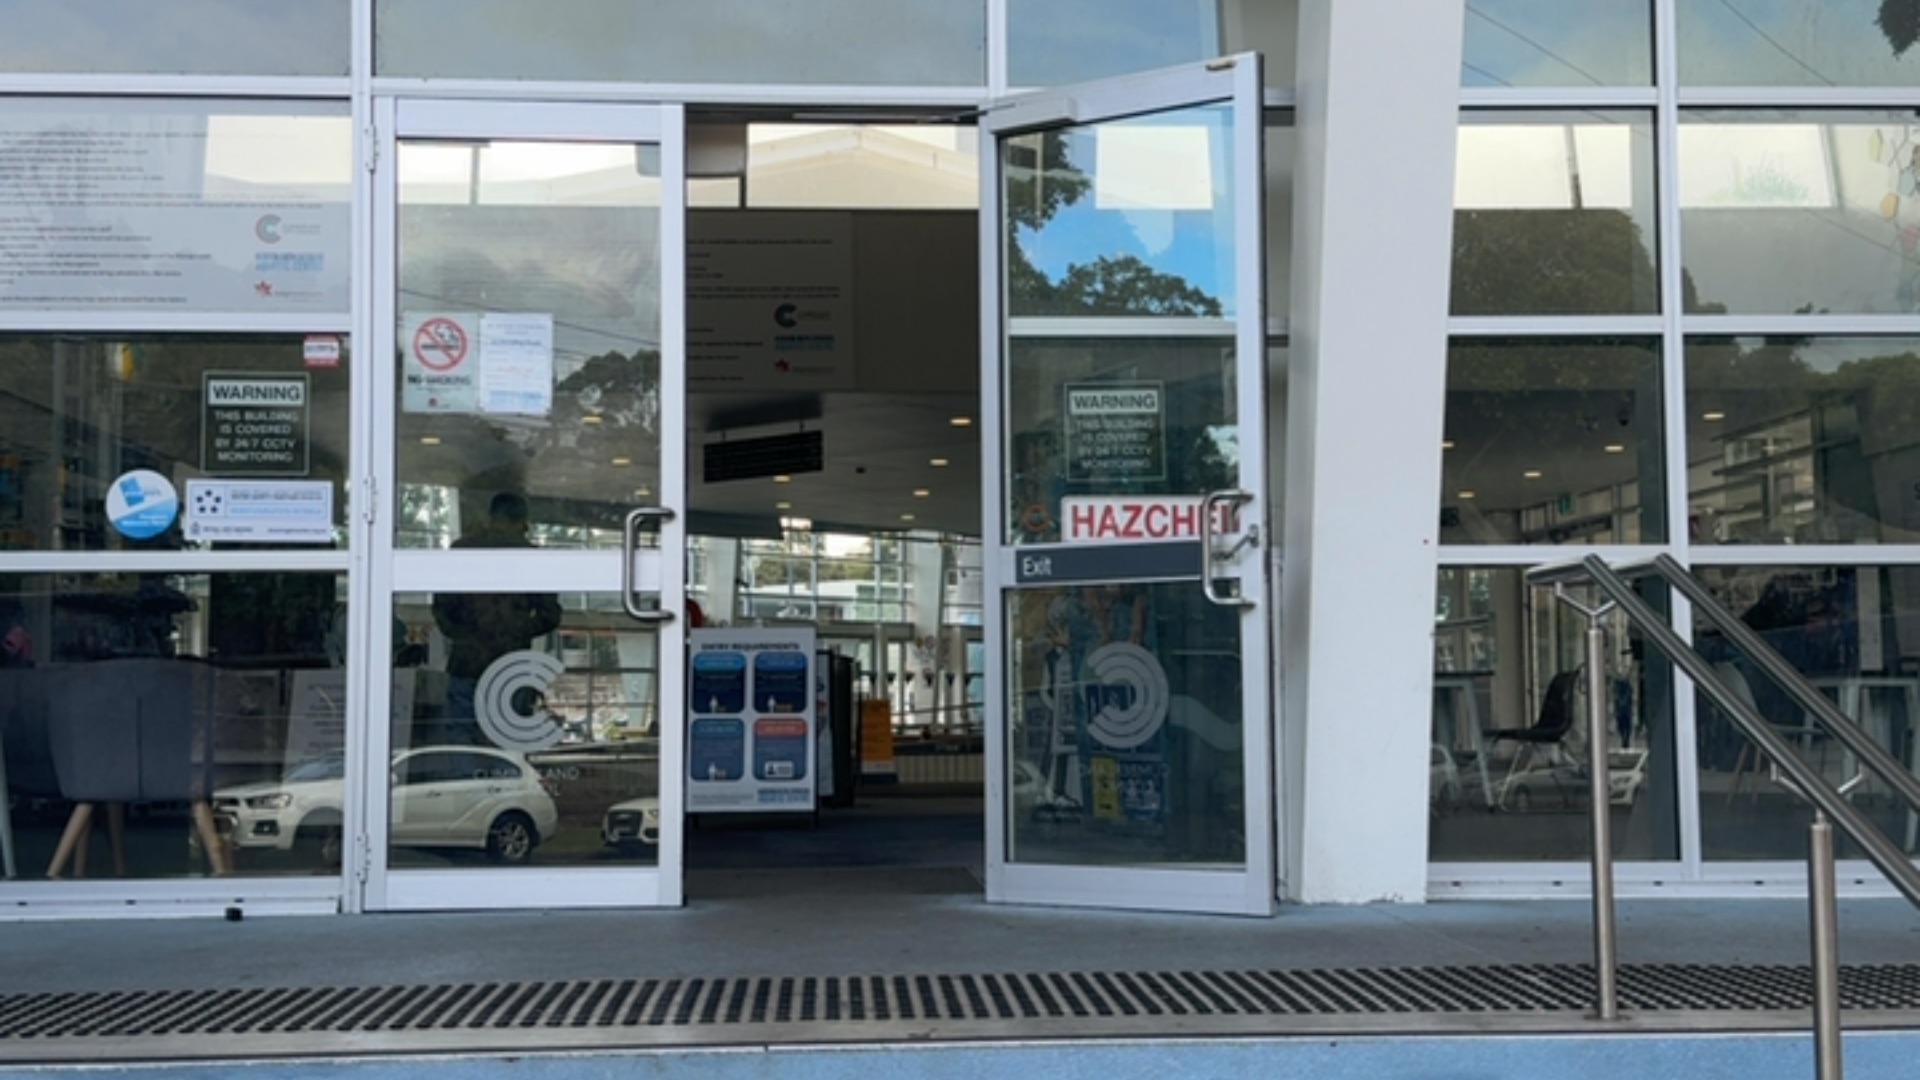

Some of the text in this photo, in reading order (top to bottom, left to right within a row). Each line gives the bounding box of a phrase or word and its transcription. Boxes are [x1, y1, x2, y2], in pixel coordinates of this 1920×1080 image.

[213, 384, 300, 401] WARNING
[1073, 393, 1155, 410] WARNING
[215, 409, 299, 422] THIS BUILDING
[220, 424, 291, 435] IS COVERED
[215, 437, 230, 448] BY
[263, 438, 296, 449] CCTV
[218, 450, 293, 462] MONITORING
[1022, 556, 1052, 576] Exit
